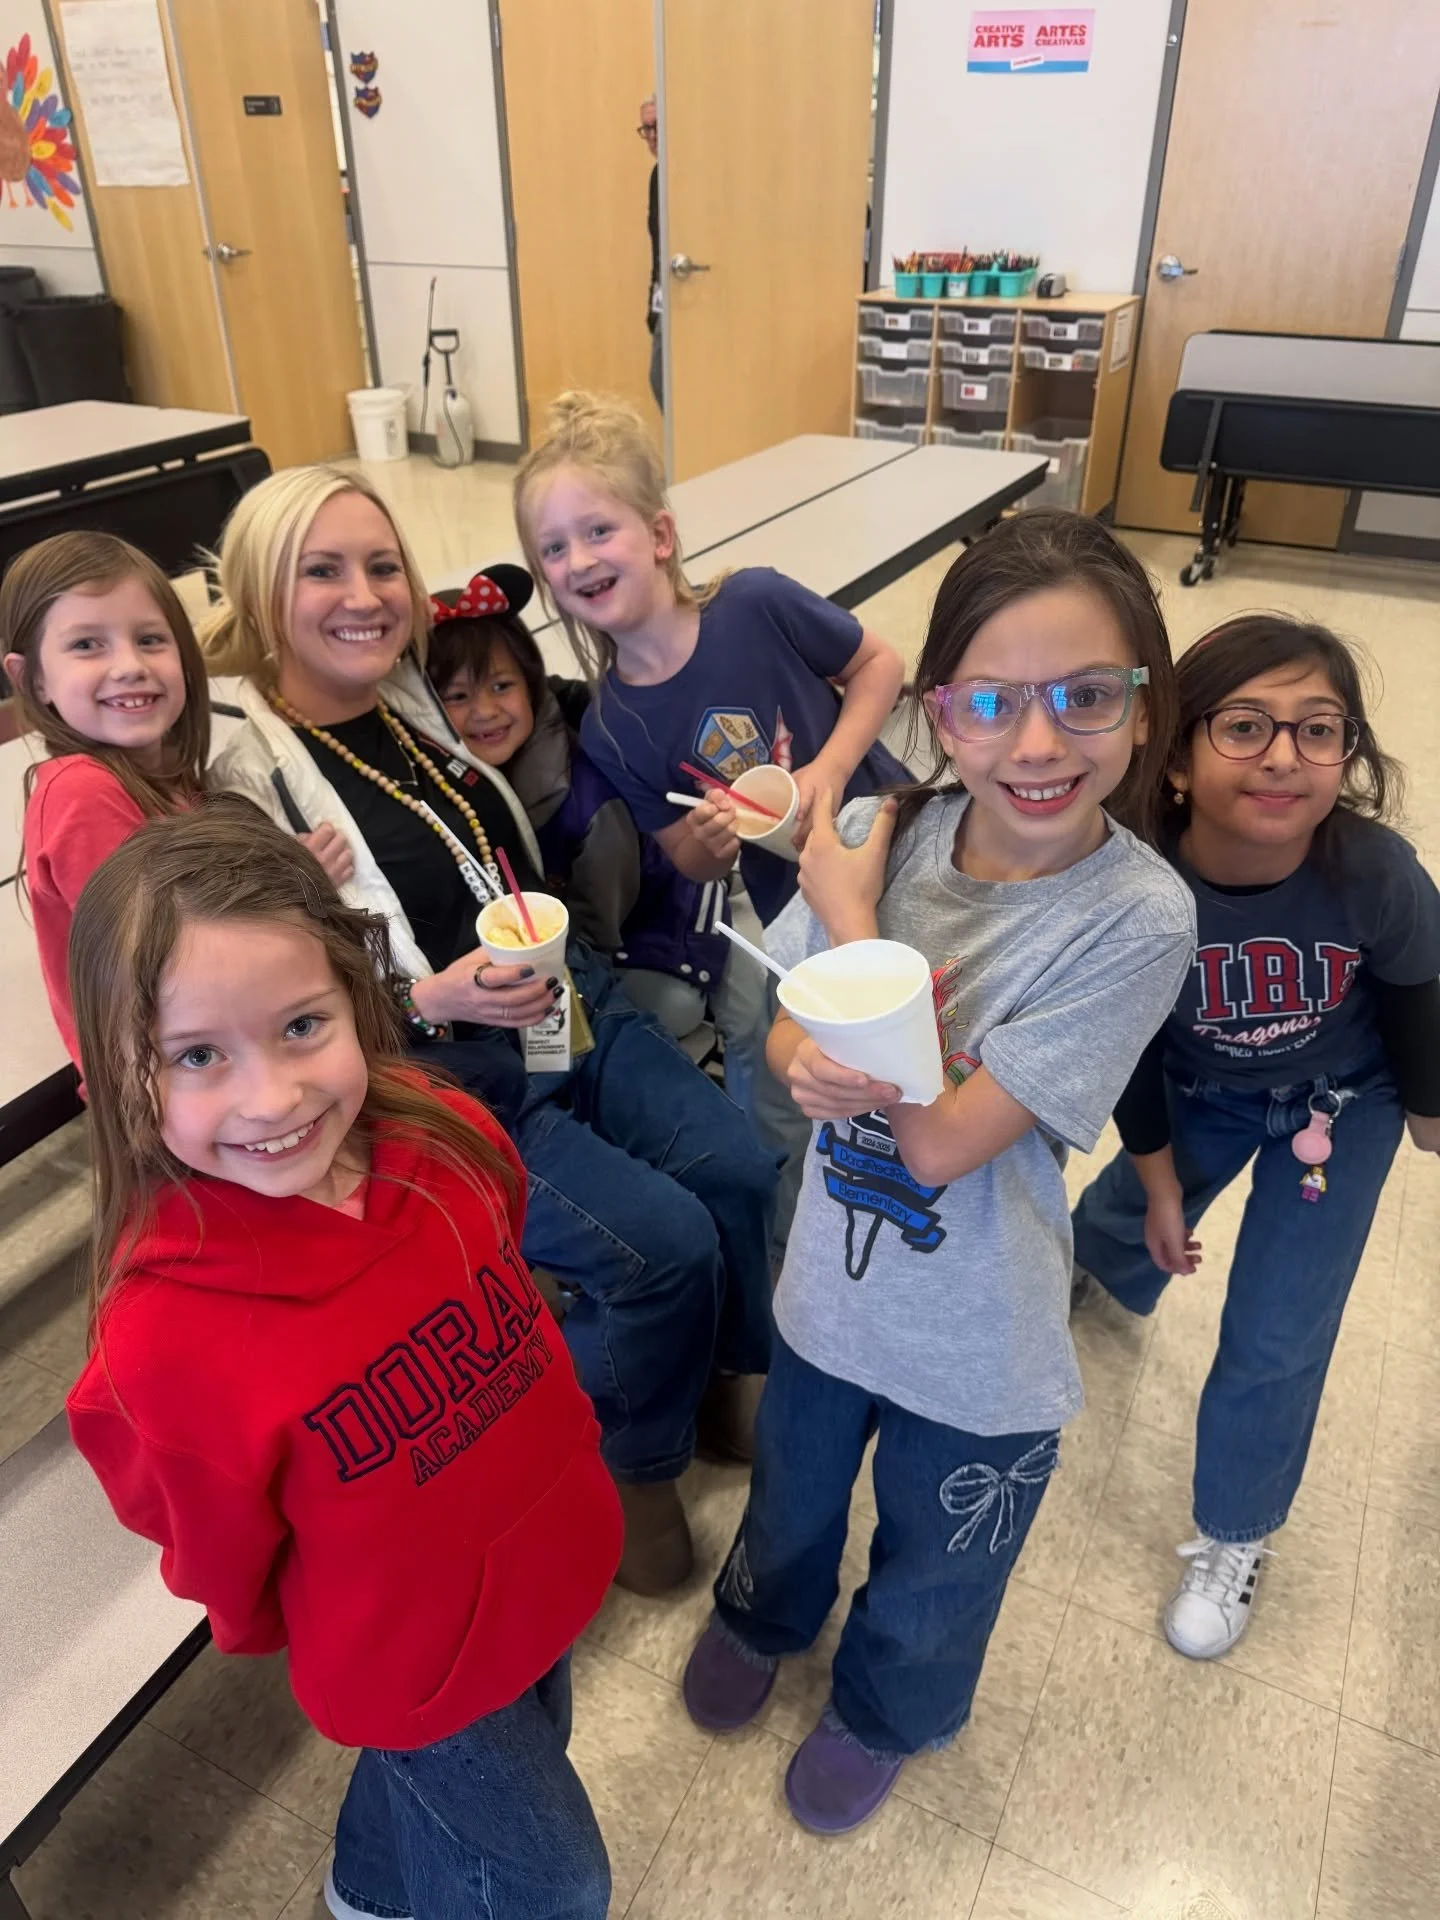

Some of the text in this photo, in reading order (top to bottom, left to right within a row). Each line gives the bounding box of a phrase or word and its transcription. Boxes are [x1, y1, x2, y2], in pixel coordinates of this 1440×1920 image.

[975, 25, 1025, 34] CREATIVE
[1036, 24, 1087, 38] ARTES
[974, 34, 1024, 48] ARTS
[1035, 38, 1086, 47] CREATIVAS
[838, 1182, 914, 1225] Elementary
[409, 1328, 554, 1487] ACADEMY
